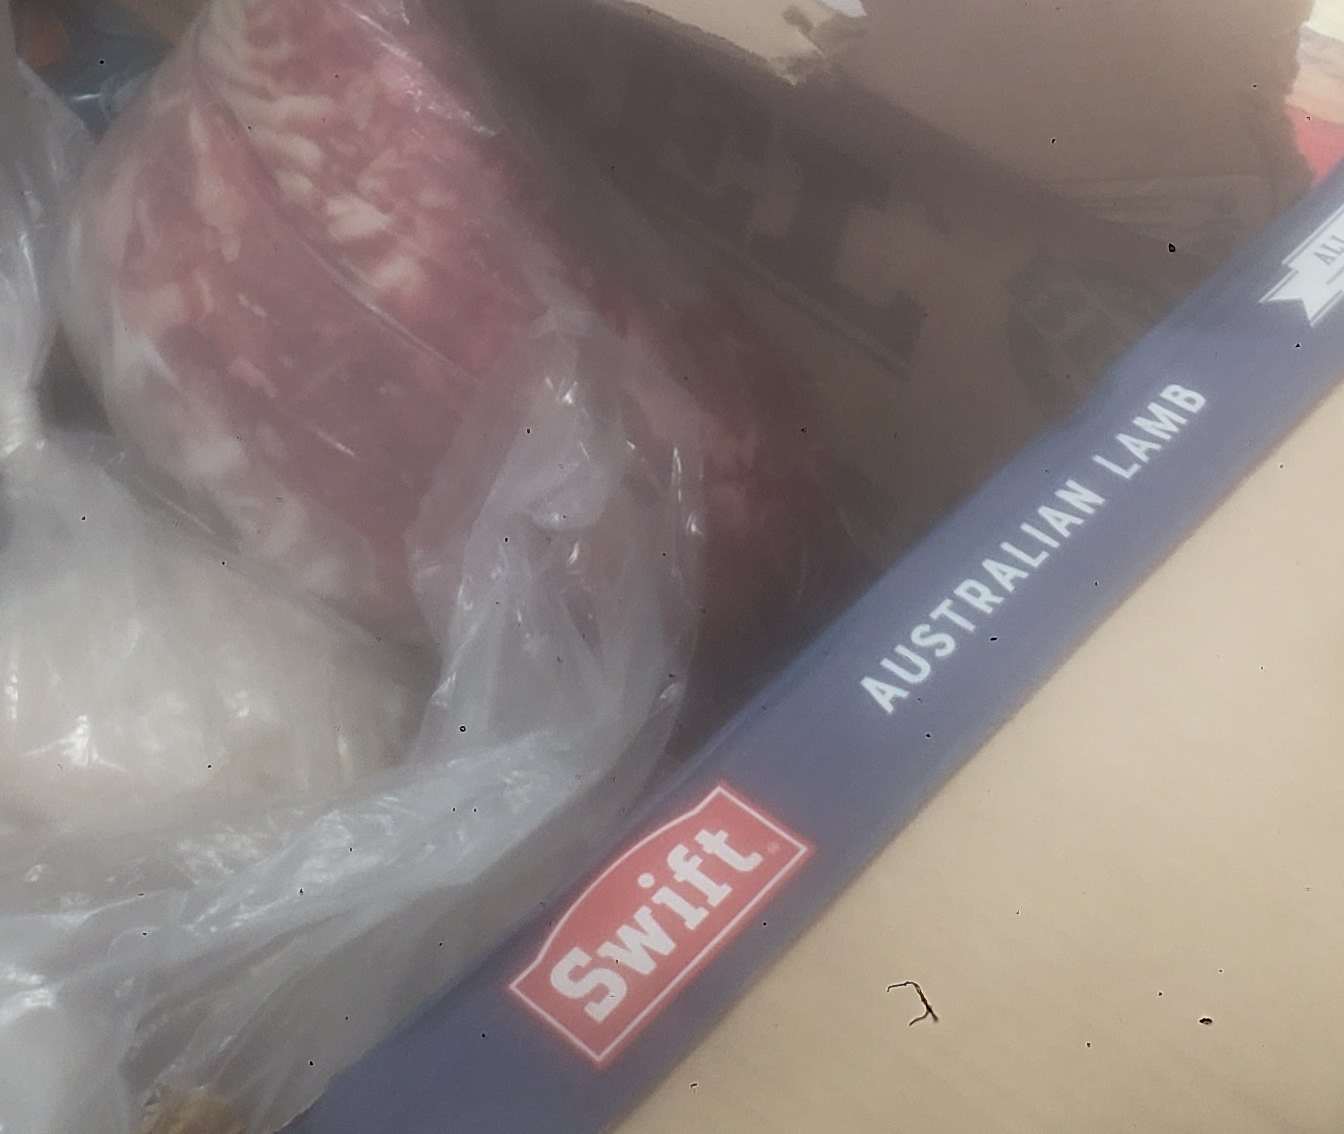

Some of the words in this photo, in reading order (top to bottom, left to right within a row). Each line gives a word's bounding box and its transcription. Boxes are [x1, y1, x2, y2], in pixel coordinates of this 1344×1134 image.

[859, 478, 1106, 714] AUSTRALIAN
[1092, 382, 1207, 480] LAMB
[549, 828, 763, 1024] Swift
